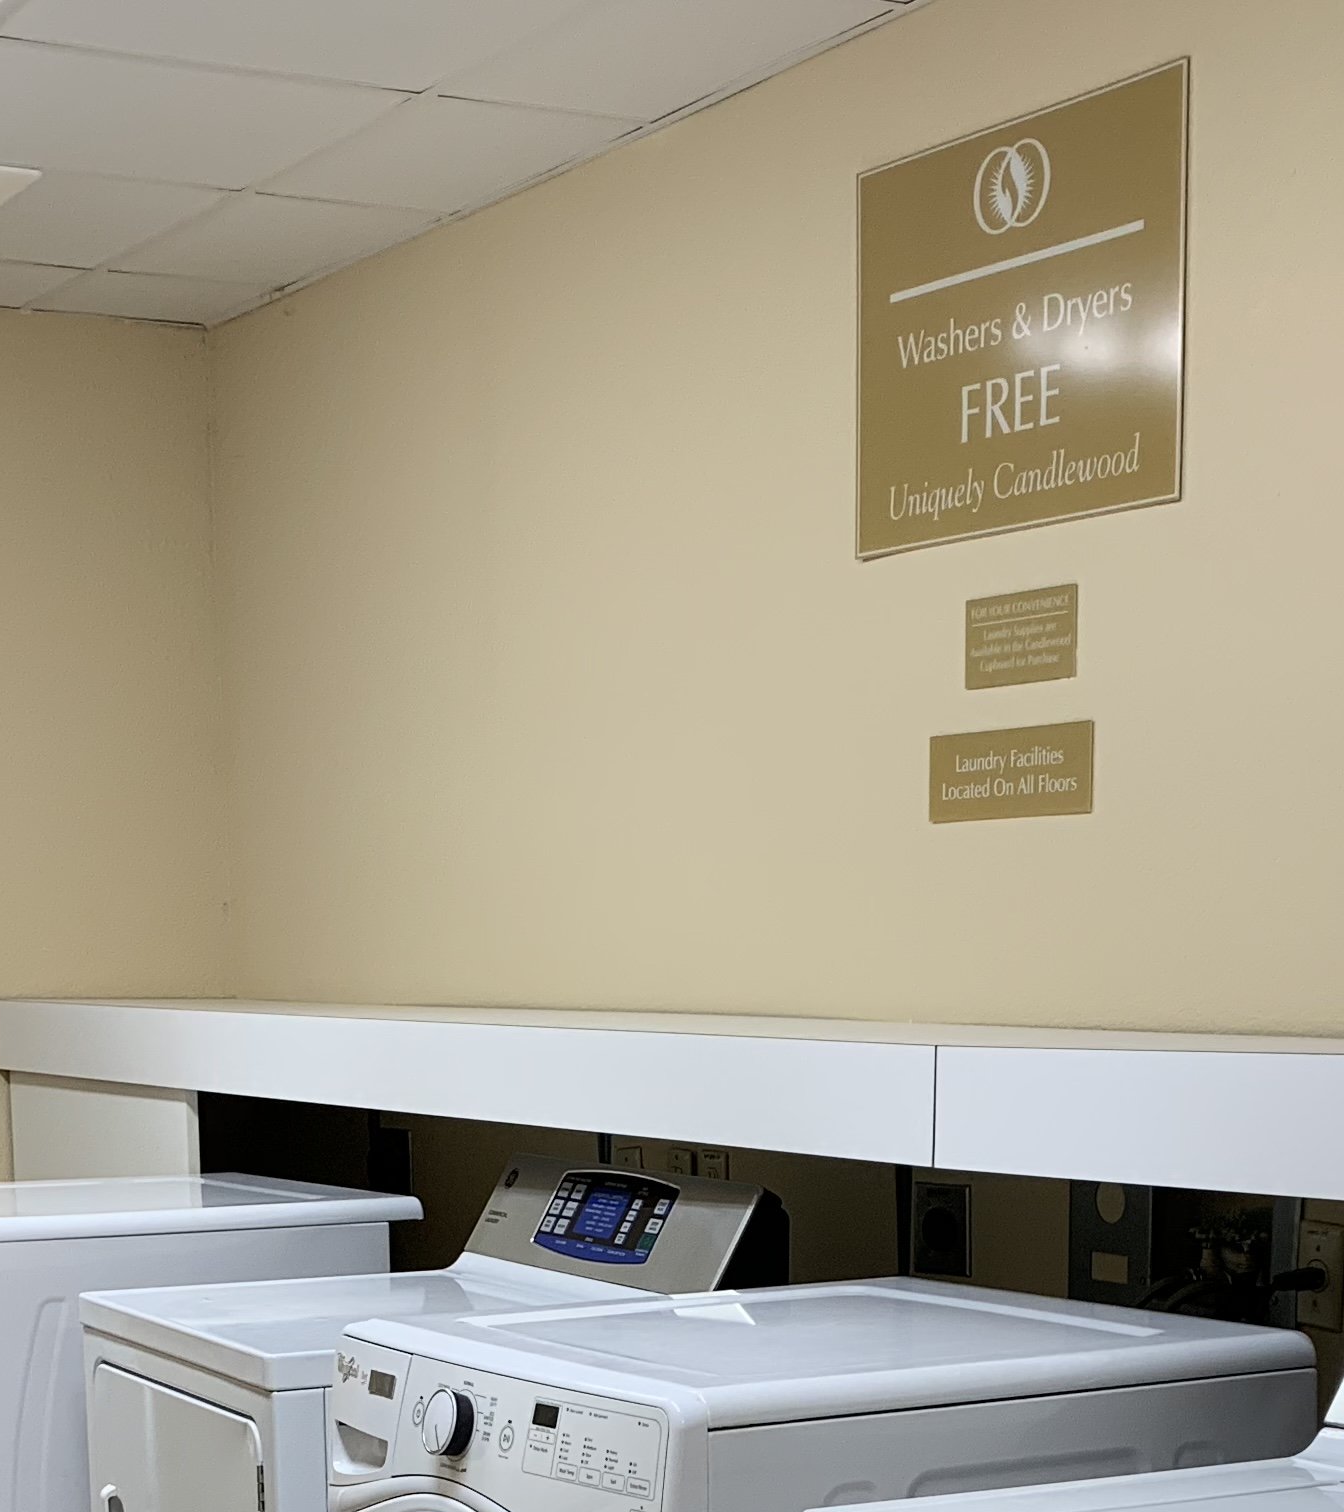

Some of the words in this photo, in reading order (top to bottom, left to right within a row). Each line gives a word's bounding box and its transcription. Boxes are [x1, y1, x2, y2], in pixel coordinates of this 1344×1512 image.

[898, 316, 1002, 369] Washers
[1012, 302, 1032, 339] &
[1042, 282, 1133, 334] Dryers
[961, 363, 1061, 444] FREE
[889, 468, 985, 521] Uniquely
[993, 432, 1141, 499] Candlewood
[943, 777, 990, 800] Located
[994, 778, 1014, 797] On
[1017, 775, 1033, 794] All
[1039, 773, 1077, 793] Floors
[956, 751, 1006, 774] Laundry
[1011, 746, 1064, 768] Facilities
